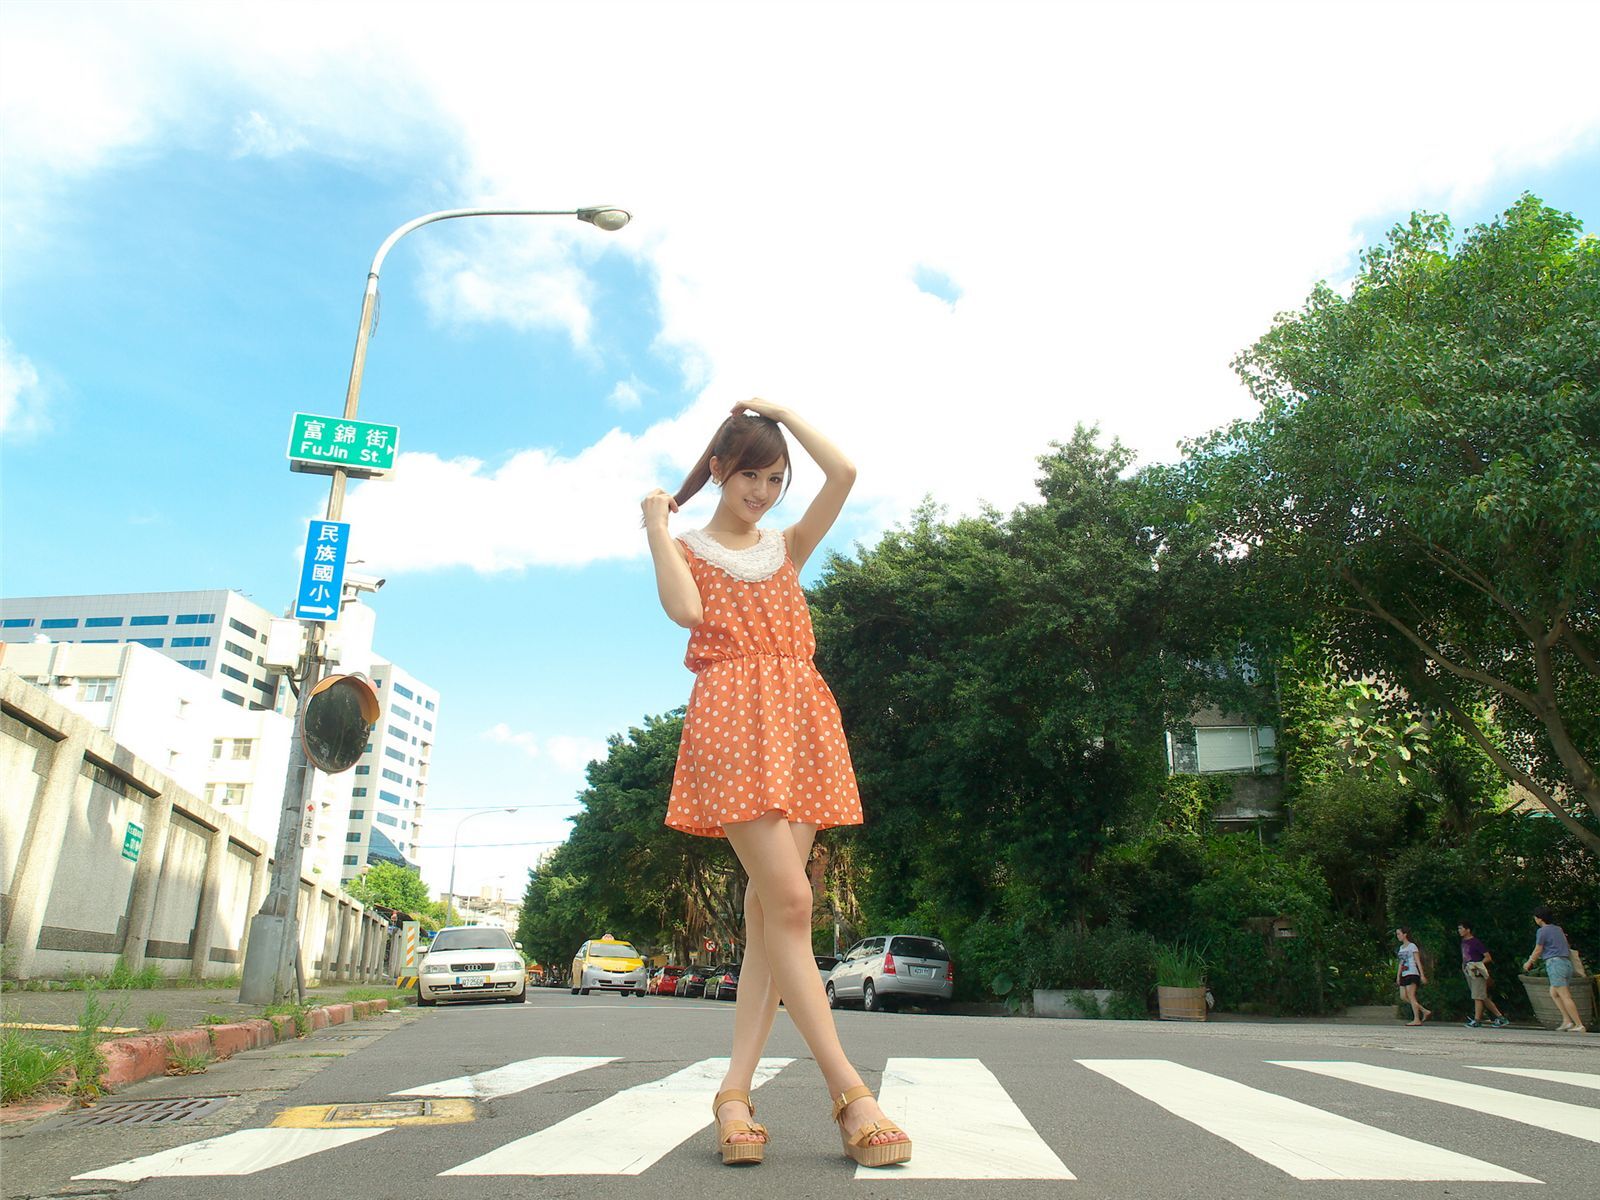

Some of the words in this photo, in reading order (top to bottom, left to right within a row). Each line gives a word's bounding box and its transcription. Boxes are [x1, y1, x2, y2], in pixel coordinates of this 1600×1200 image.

[303, 419, 389, 449] 富錦街
[300, 441, 348, 459] FuJin
[359, 448, 382, 464] St.
[309, 524, 339, 602] 民族國小
